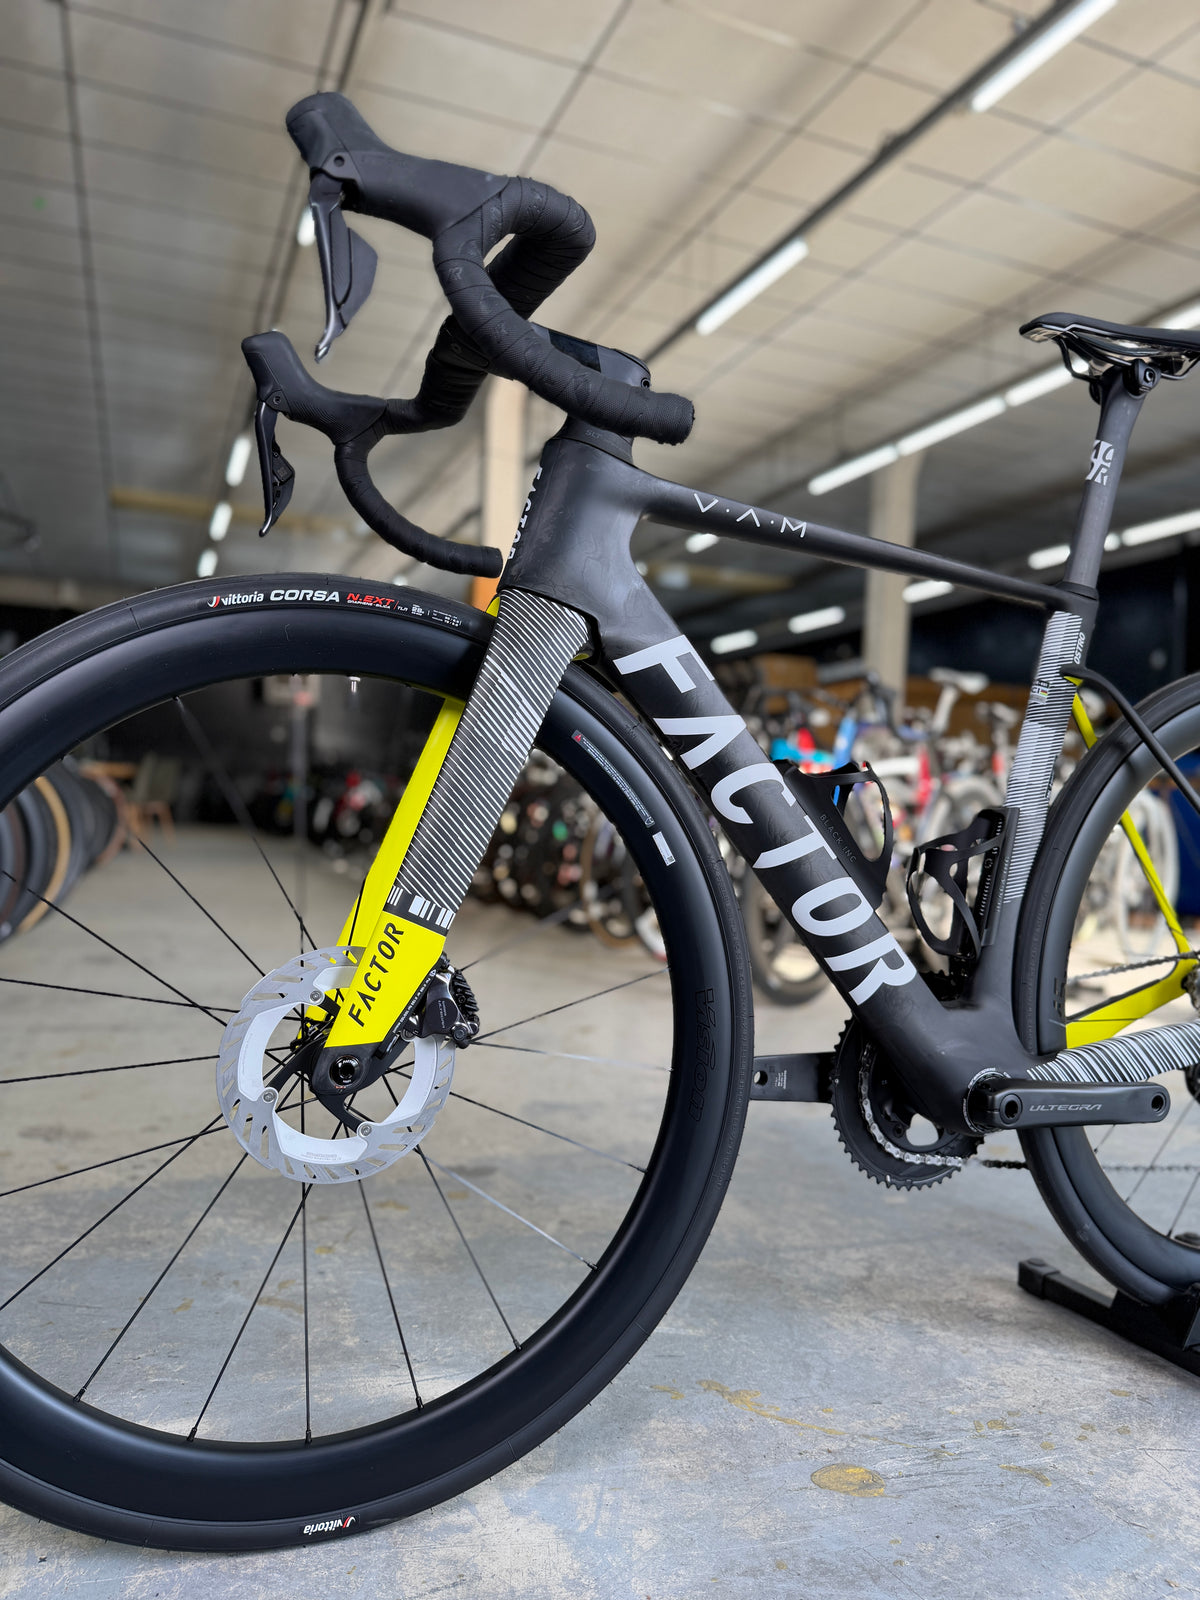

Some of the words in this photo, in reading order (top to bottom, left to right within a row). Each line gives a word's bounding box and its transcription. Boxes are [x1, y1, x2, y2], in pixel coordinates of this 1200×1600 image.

[508, 466, 543, 560] CTOR
[221, 591, 264, 606] vittoria
[270, 589, 340, 602] CORSA
[347, 593, 395, 606] N.EXT
[1073, 632, 1086, 664] OSTRO
[613, 634, 917, 1006] FACTOR
[820, 814, 843, 845] BLACK
[843, 846, 857, 863] INC
[348, 922, 405, 1027] FACTOR
[1029, 1104, 1103, 1112] ULTEGRA
[303, 1519, 343, 1535] vittoria
